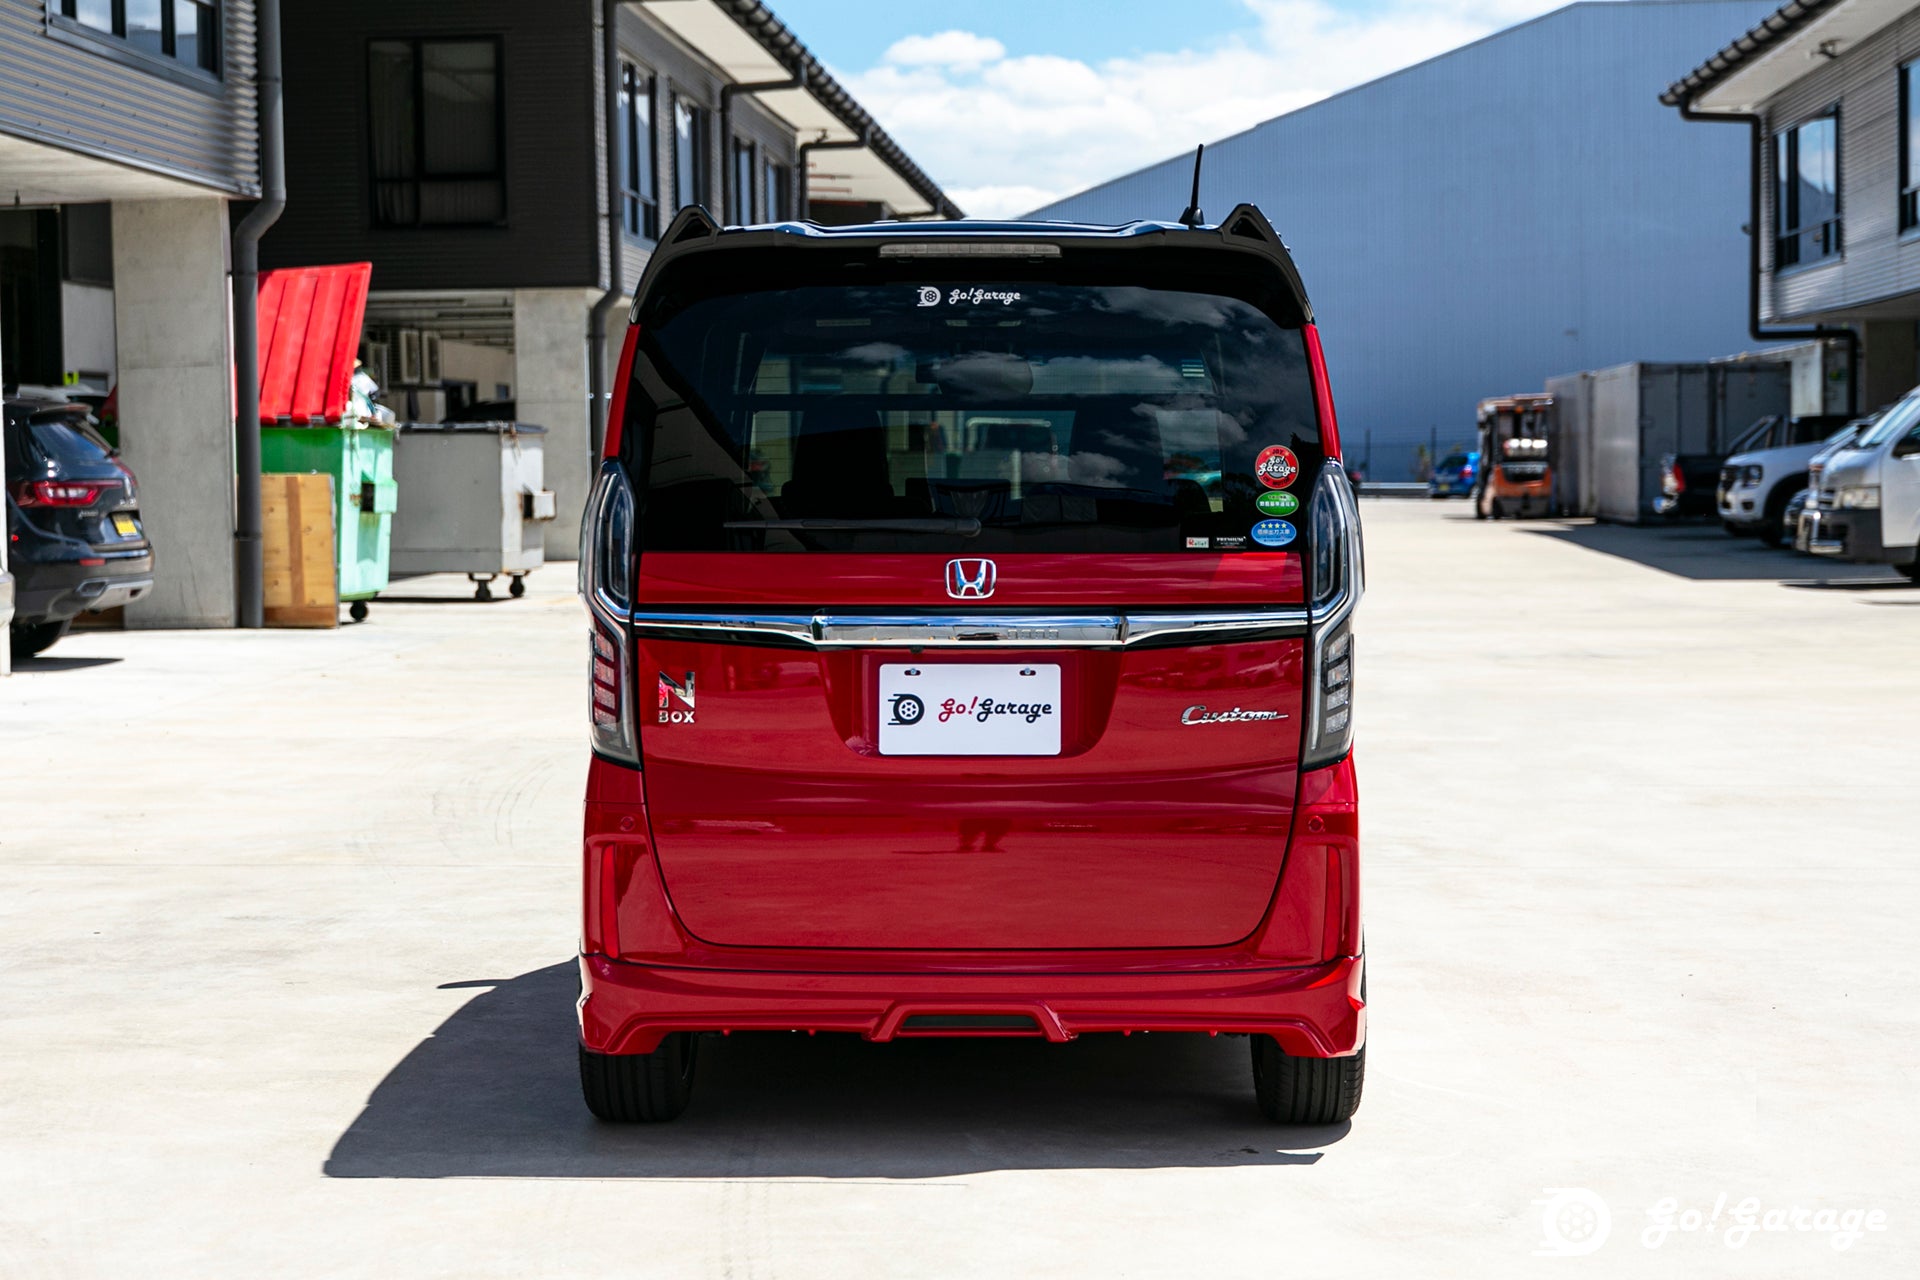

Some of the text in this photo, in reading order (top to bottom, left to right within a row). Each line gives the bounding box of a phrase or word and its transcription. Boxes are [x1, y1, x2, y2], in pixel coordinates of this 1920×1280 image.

[1257, 462, 1296, 477] Garage
[658, 670, 696, 708] N
[658, 710, 695, 723] BOX
[1181, 705, 1289, 725] Custom
